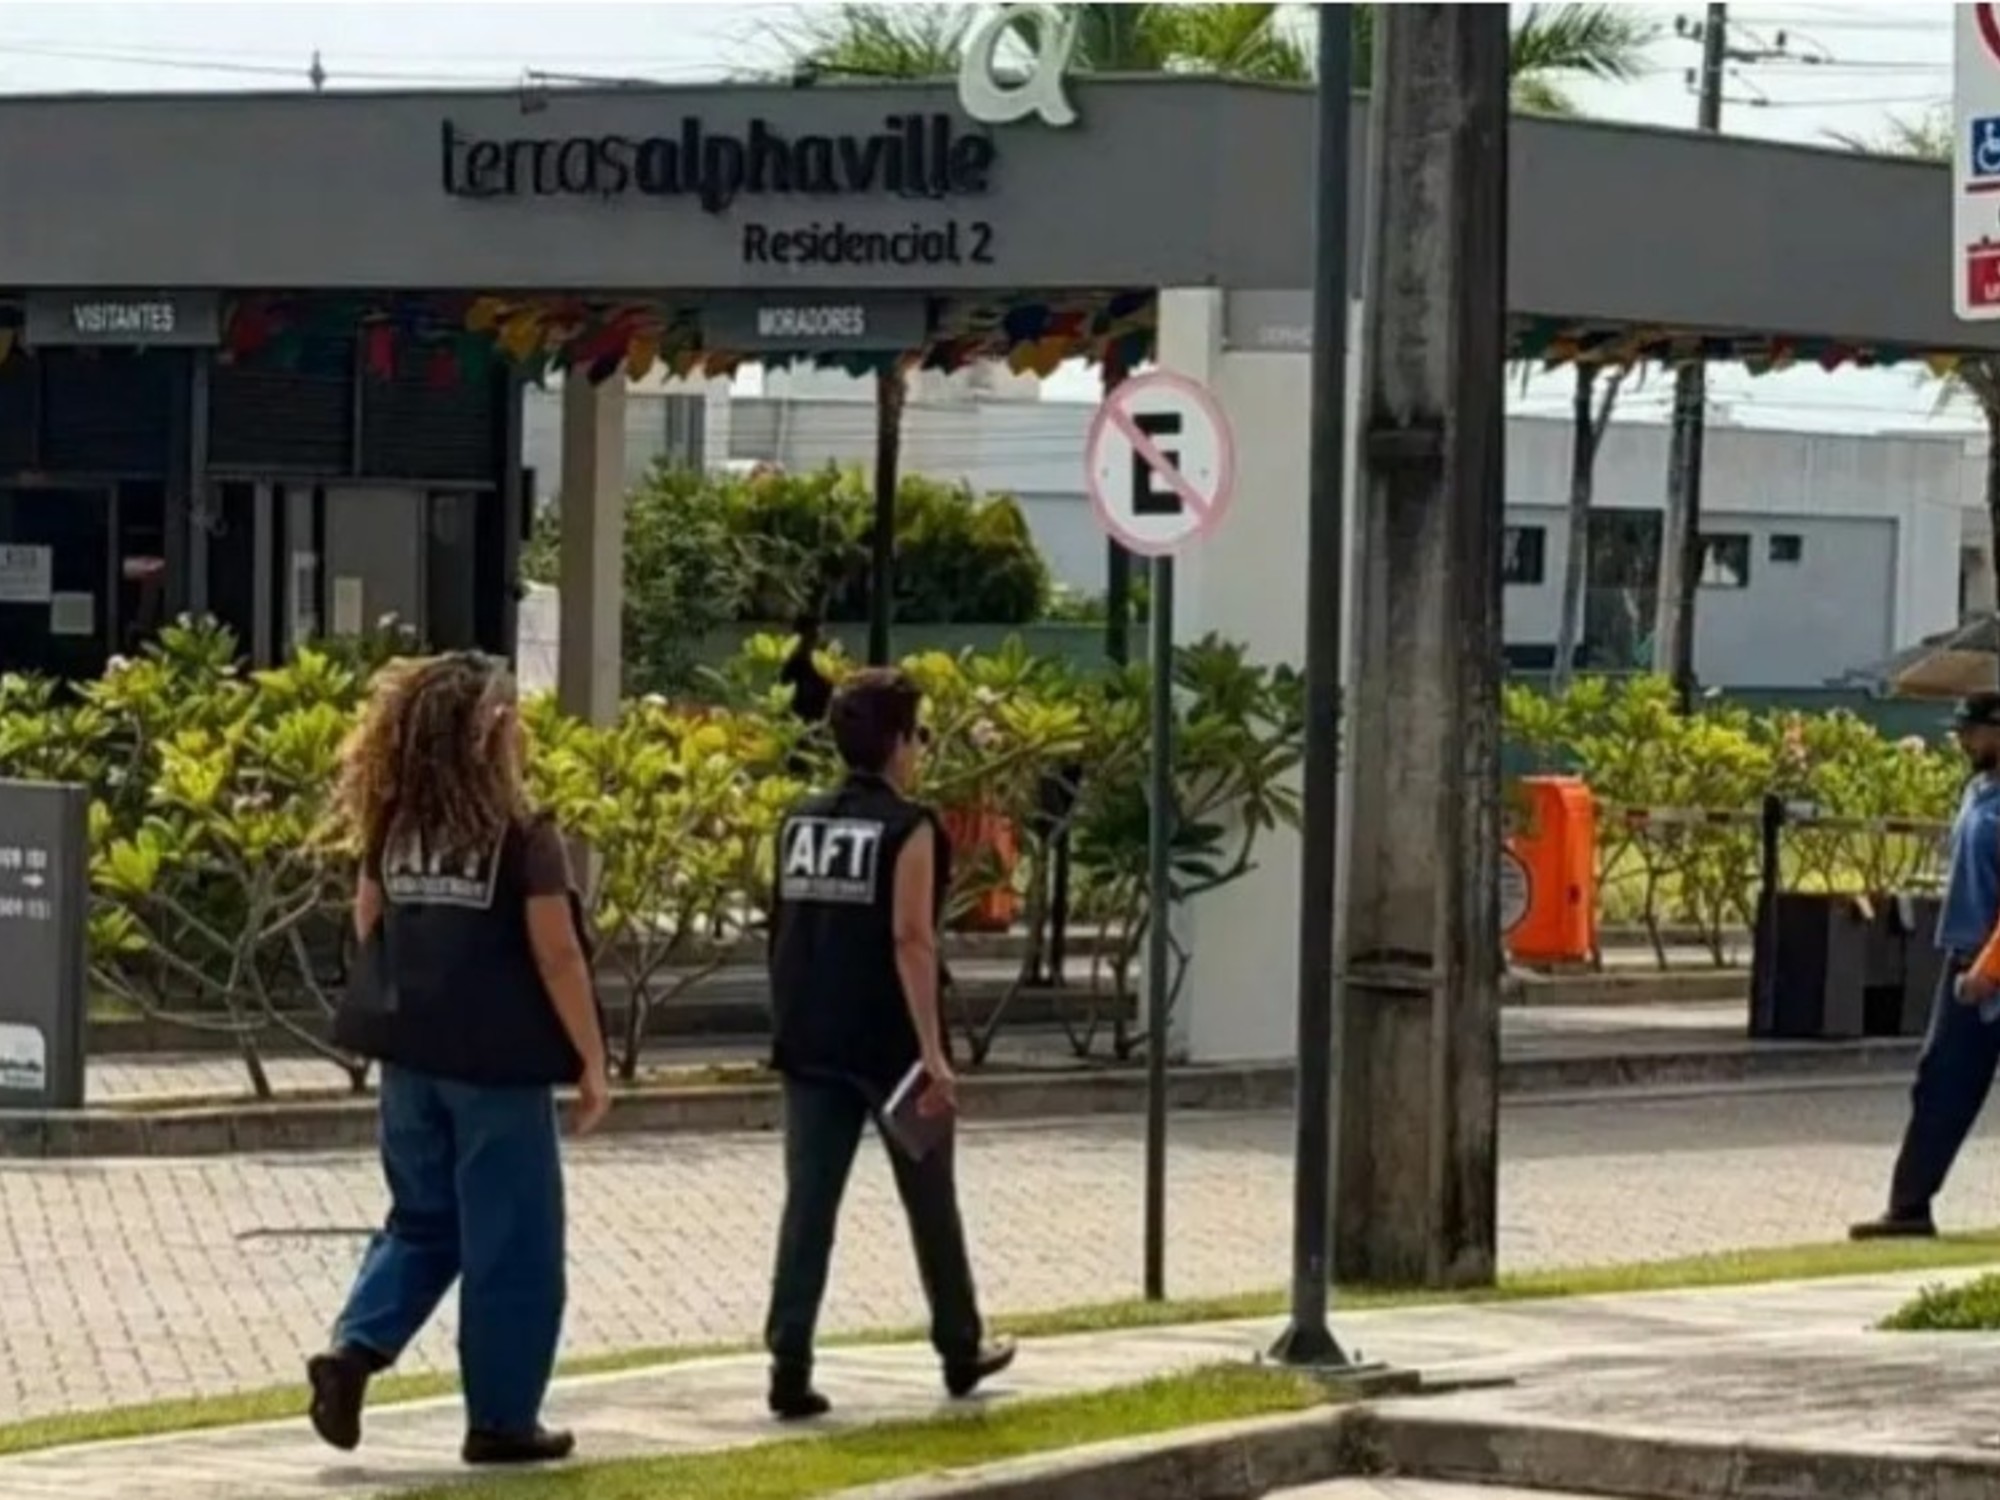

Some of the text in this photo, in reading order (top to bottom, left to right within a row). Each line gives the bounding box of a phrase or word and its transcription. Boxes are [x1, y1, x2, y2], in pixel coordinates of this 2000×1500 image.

[743, 219, 994, 265] Residencial 2
[73, 302, 174, 333] VISITANTES
[758, 306, 865, 336] MORADORES
[1132, 411, 1183, 516] E
[785, 824, 878, 877] AFT
